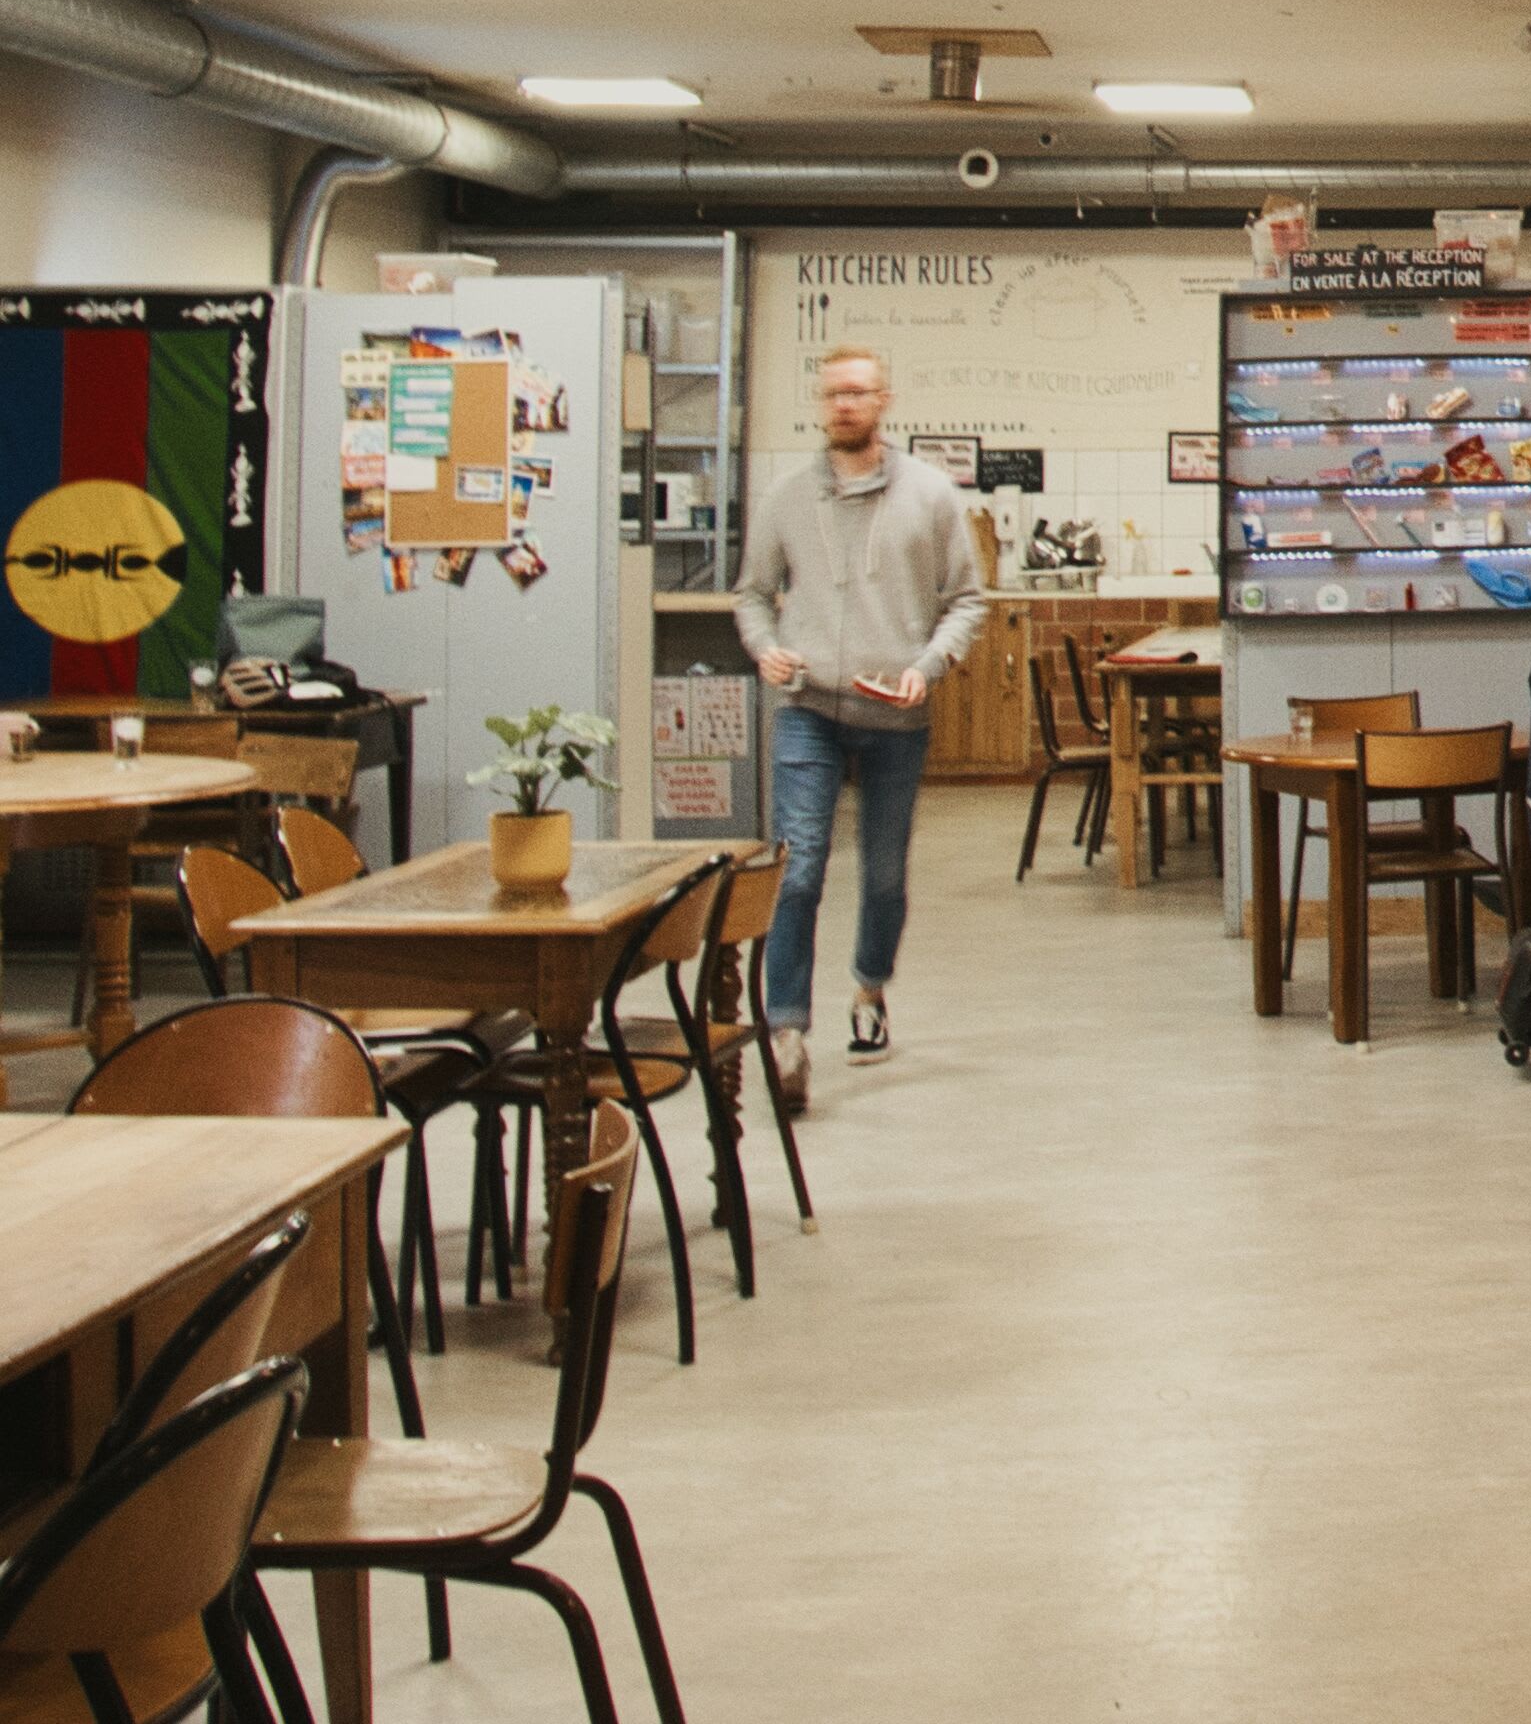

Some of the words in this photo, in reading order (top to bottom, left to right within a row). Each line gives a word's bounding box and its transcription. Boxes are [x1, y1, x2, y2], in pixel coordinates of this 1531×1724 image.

[1292, 252, 1318, 268] FOR
[1323, 251, 1356, 267] SALE
[1360, 250, 1381, 265] AT
[1384, 249, 1408, 265] THE
[1411, 248, 1483, 265] RECEPTION
[797, 254, 906, 285] KITCHEN
[917, 254, 994, 286] RULES
[1292, 275, 1311, 292] EN
[1311, 272, 1355, 290] VENTE
[1371, 270, 1392, 289] LA
